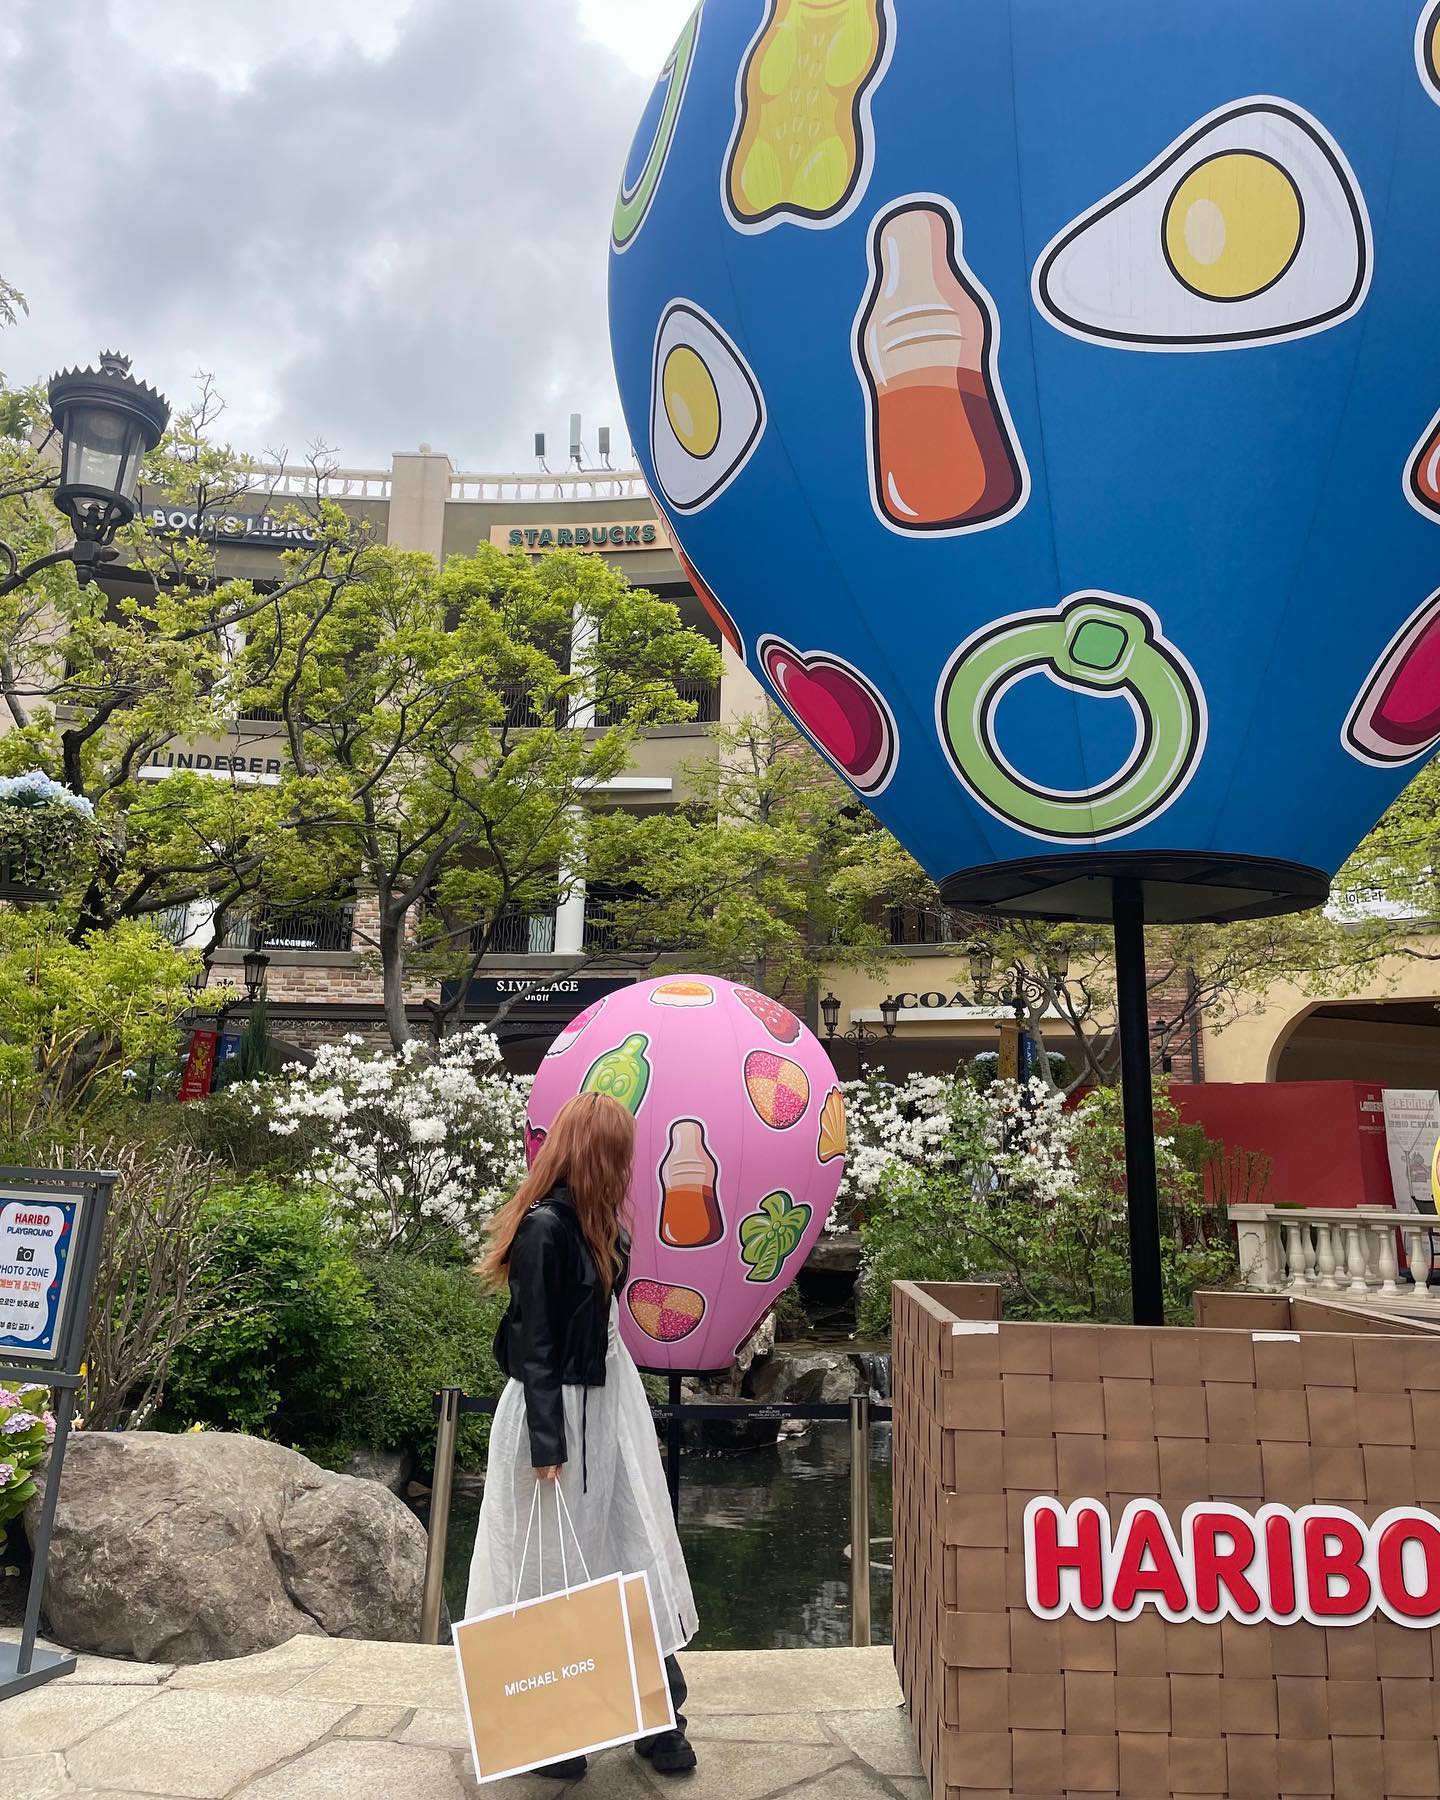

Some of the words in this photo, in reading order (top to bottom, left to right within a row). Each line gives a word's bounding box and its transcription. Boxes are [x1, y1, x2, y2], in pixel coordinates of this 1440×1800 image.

[152, 509, 238, 533] BOOS
[508, 524, 656, 545] STARBUCKS
[152, 752, 294, 774] LINDEBER
[15, 1213, 50, 1225] HARIBO
[7, 1226, 54, 1237] PLAYGROUND
[26, 1267, 49, 1278] ZONE
[1034, 1507, 1440, 1618] HARIBO
[504, 1670, 558, 1697] MICHAEL
[561, 1658, 595, 1679] KORS
